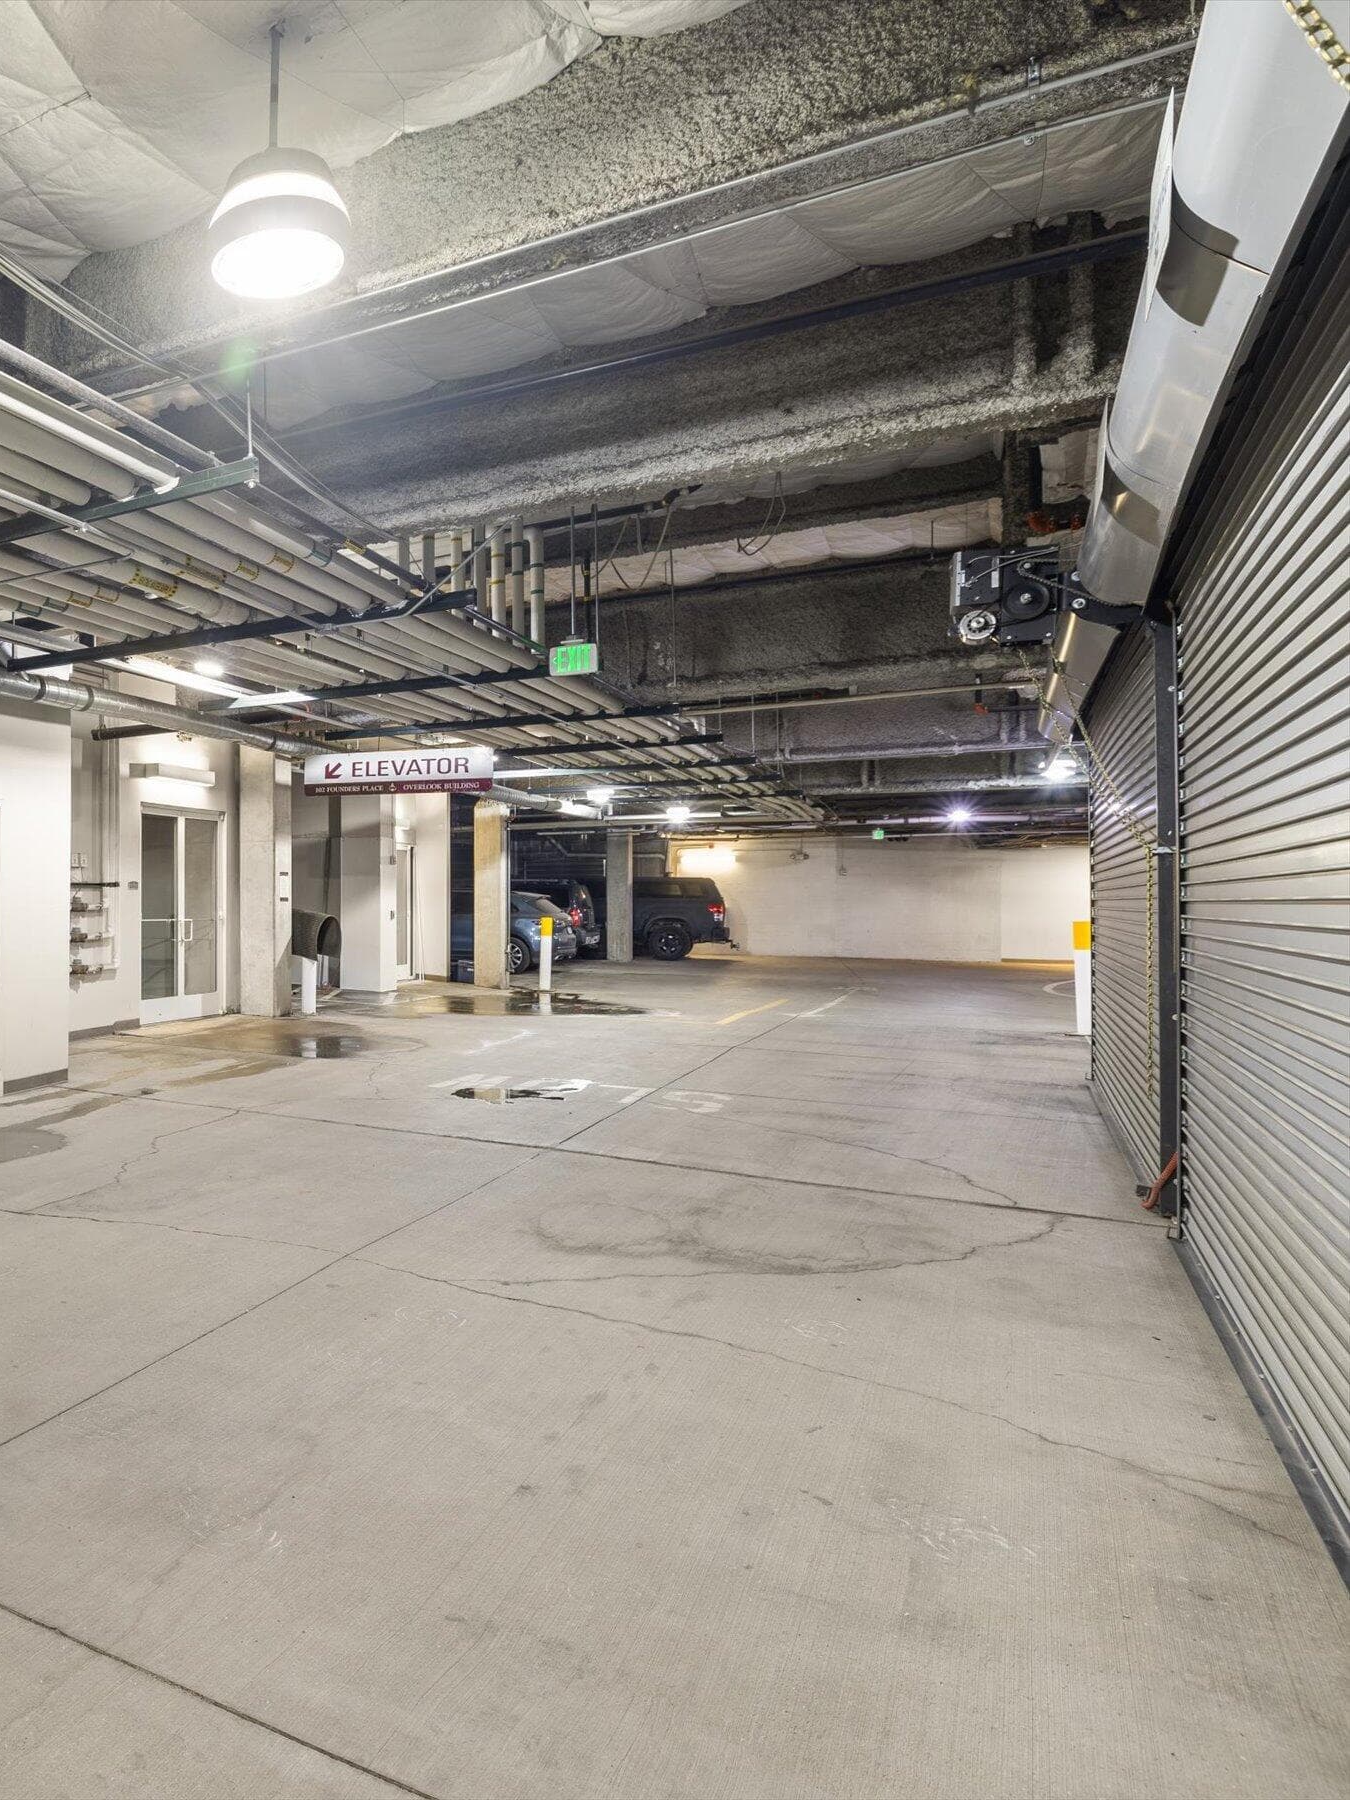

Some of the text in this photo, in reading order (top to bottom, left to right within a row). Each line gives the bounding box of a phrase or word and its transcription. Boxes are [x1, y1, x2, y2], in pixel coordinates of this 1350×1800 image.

[557, 644, 591, 673] EXIT
[351, 756, 470, 778] ELEVATOR
[326, 784, 361, 793] FOUNDERS
[361, 783, 384, 792] PLACE
[402, 780, 480, 791] OVERLOOK BUILDING
